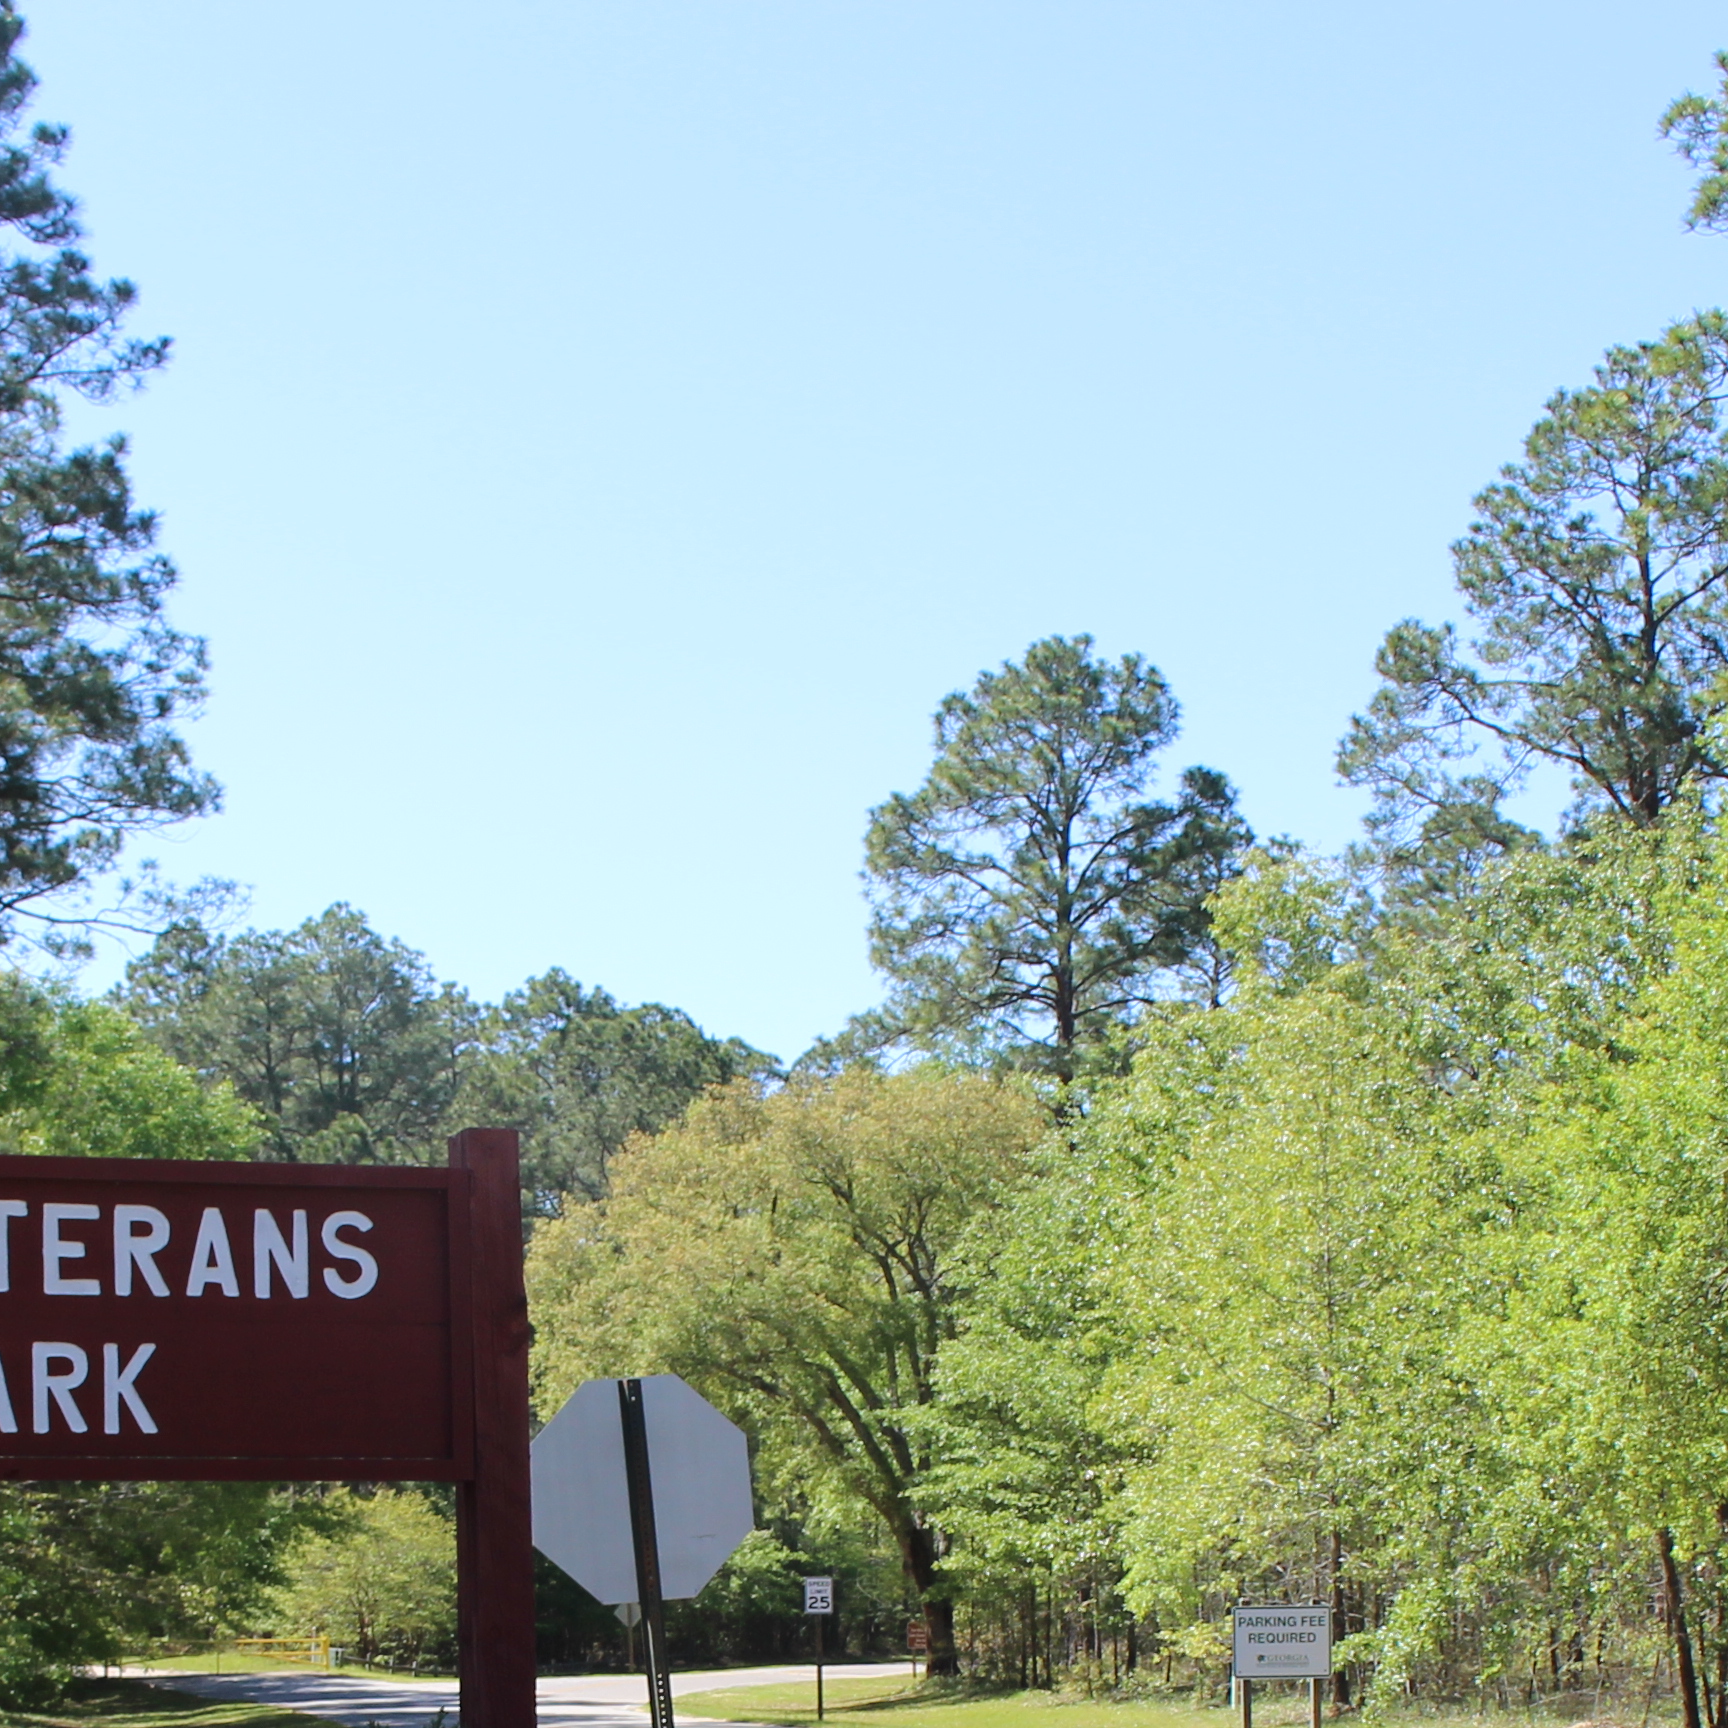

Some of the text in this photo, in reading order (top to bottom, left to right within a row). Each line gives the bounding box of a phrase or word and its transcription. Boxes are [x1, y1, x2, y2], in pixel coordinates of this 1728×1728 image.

[808, 1597, 830, 1609] 25
[1238, 1615, 1326, 1627] PARKING FEE
[1248, 1632, 1317, 1644] REQUIRED
